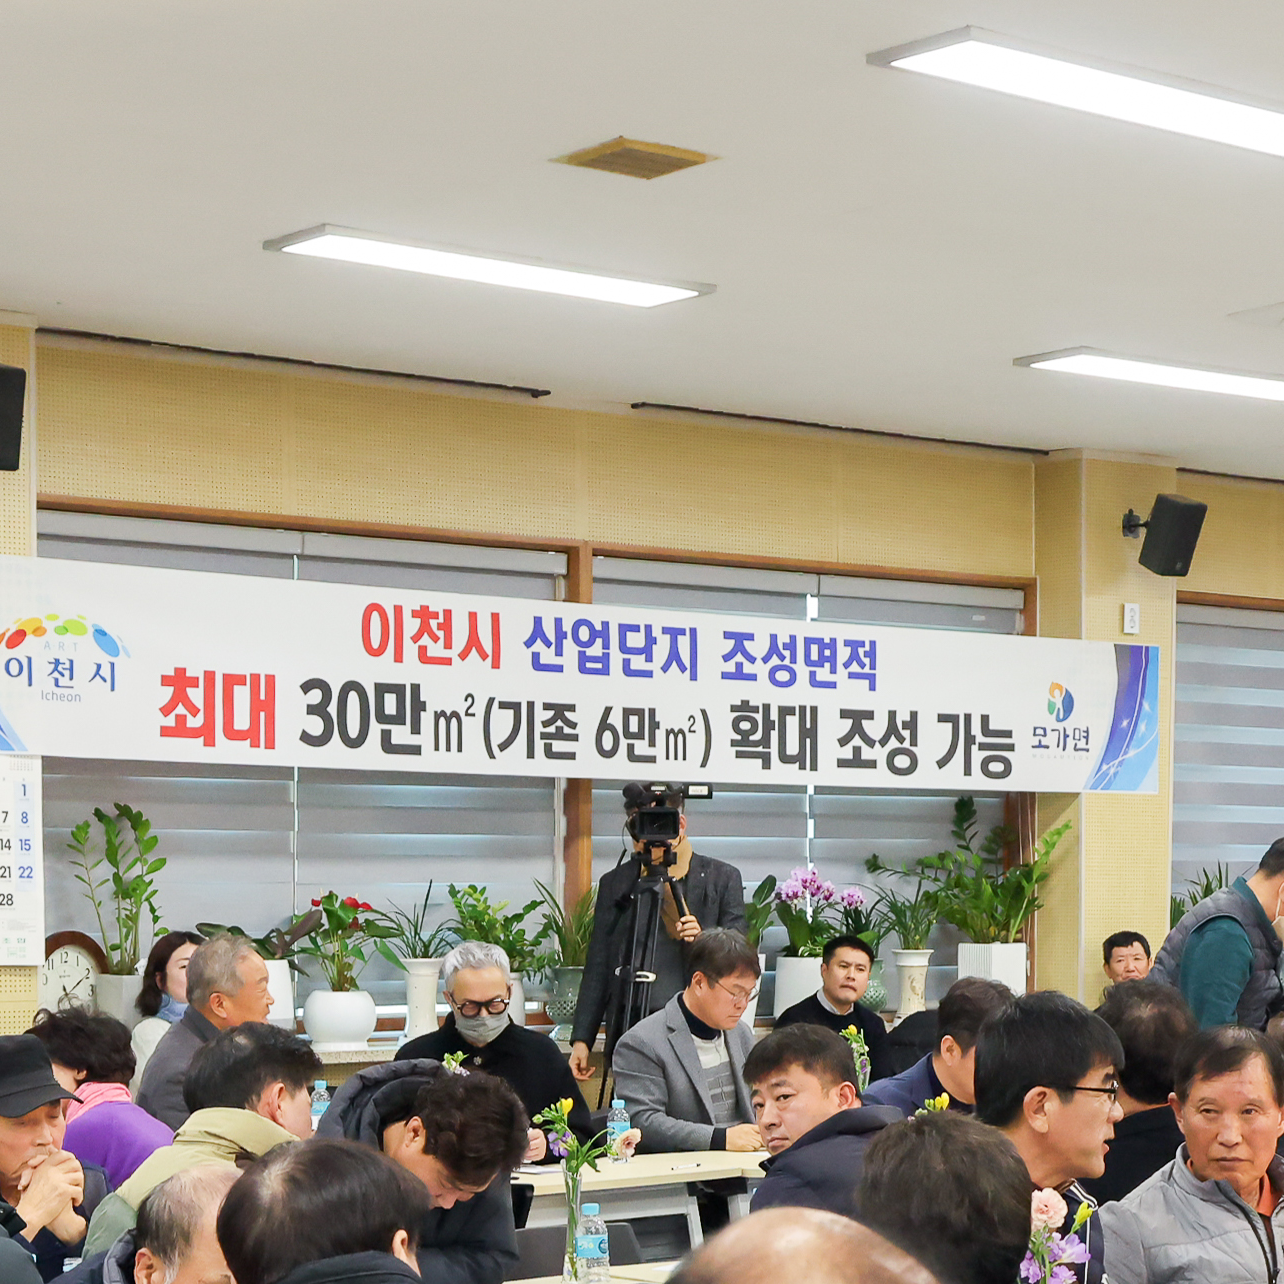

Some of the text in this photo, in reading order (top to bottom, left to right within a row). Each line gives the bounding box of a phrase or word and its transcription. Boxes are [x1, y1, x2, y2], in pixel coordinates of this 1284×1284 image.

[361, 602, 877, 691] 이천시 산업단지 조성면적
[4, 655, 116, 692] 이천시
[41, 690, 81, 702] Icheon
[159, 667, 276, 749] 최대
[730, 700, 818, 772] 확대
[836, 708, 919, 776] 조성
[935, 713, 1015, 779] 가능
[1031, 726, 1090, 752] 모가면
[21, 784, 27, 796] 1
[1, 811, 9, 823] 7
[20, 812, 29, 824] 8
[0, 839, 12, 850] 14
[20, 839, 32, 851] 15
[0, 866, 12, 878] 21
[19, 866, 33, 878] 22
[0, 894, 14, 906] 28
[60, 951, 68, 964] 12
[47, 958, 54, 970] 11
[85, 967, 91, 979] 2
[87, 984, 94, 997] 3
